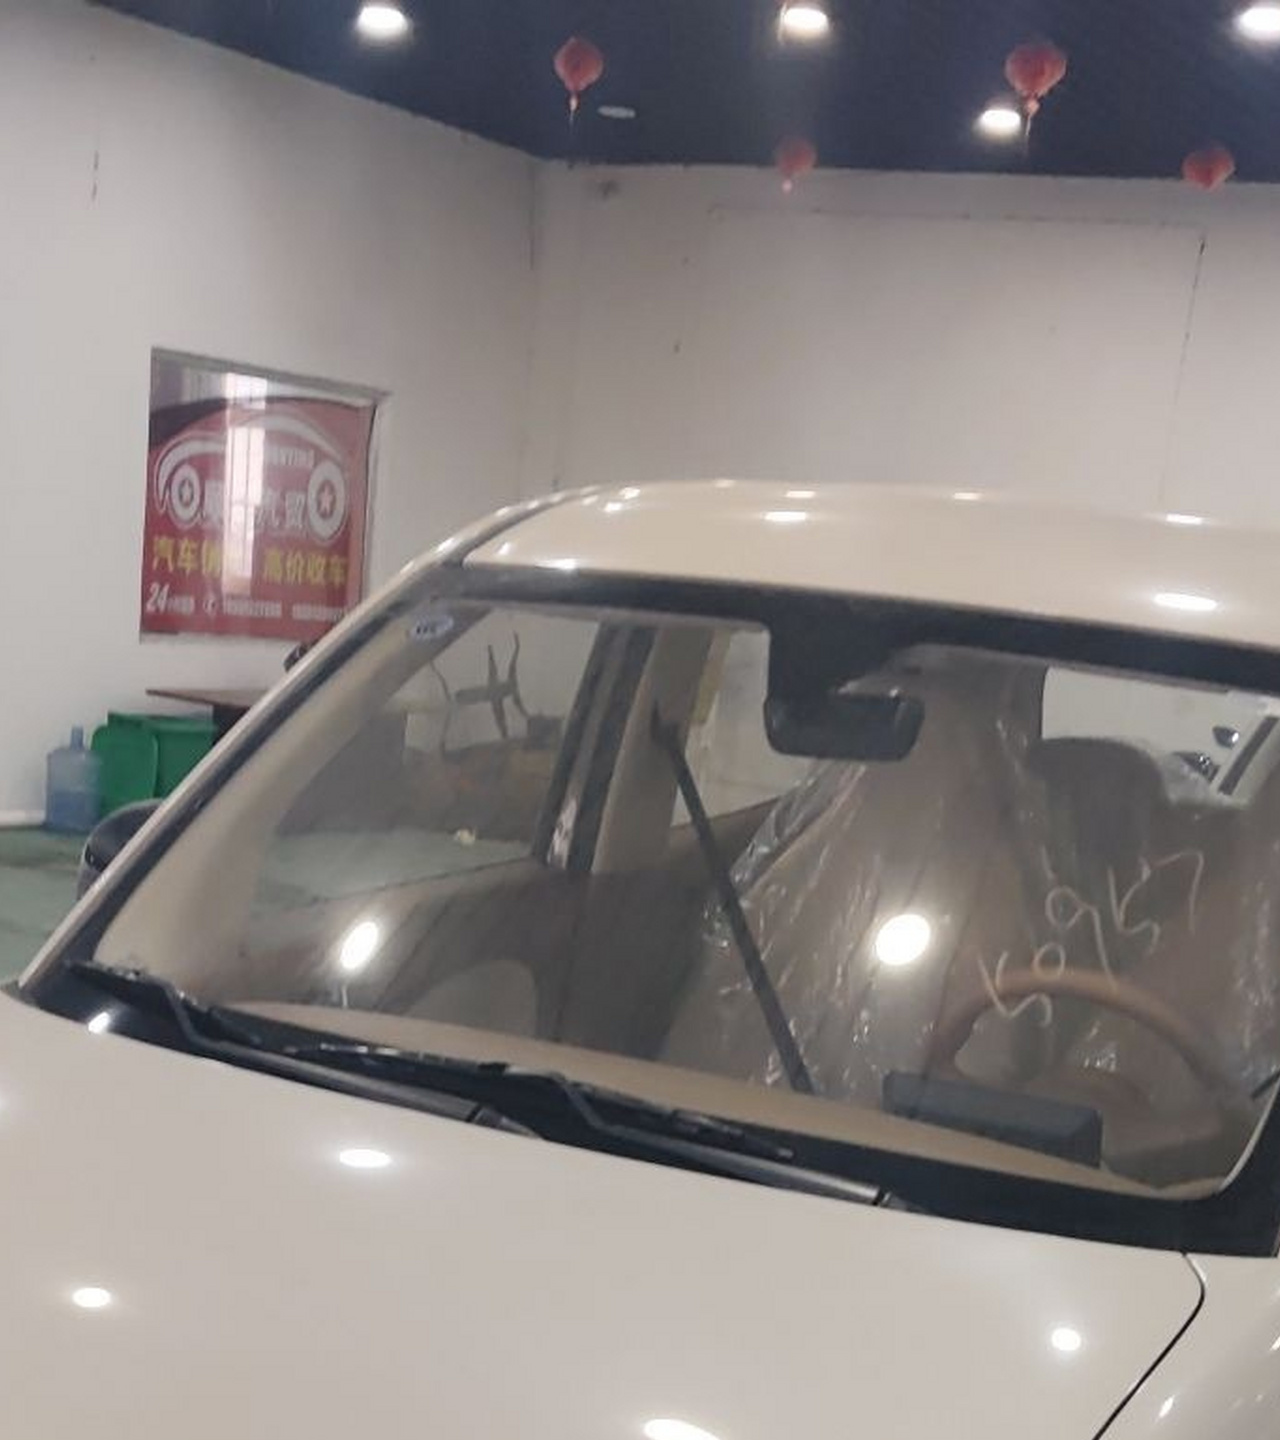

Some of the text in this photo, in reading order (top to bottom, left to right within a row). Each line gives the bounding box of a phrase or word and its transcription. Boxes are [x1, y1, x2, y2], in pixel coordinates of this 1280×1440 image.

[263, 549, 347, 588] 高价收车
[146, 582, 169, 613] 24
